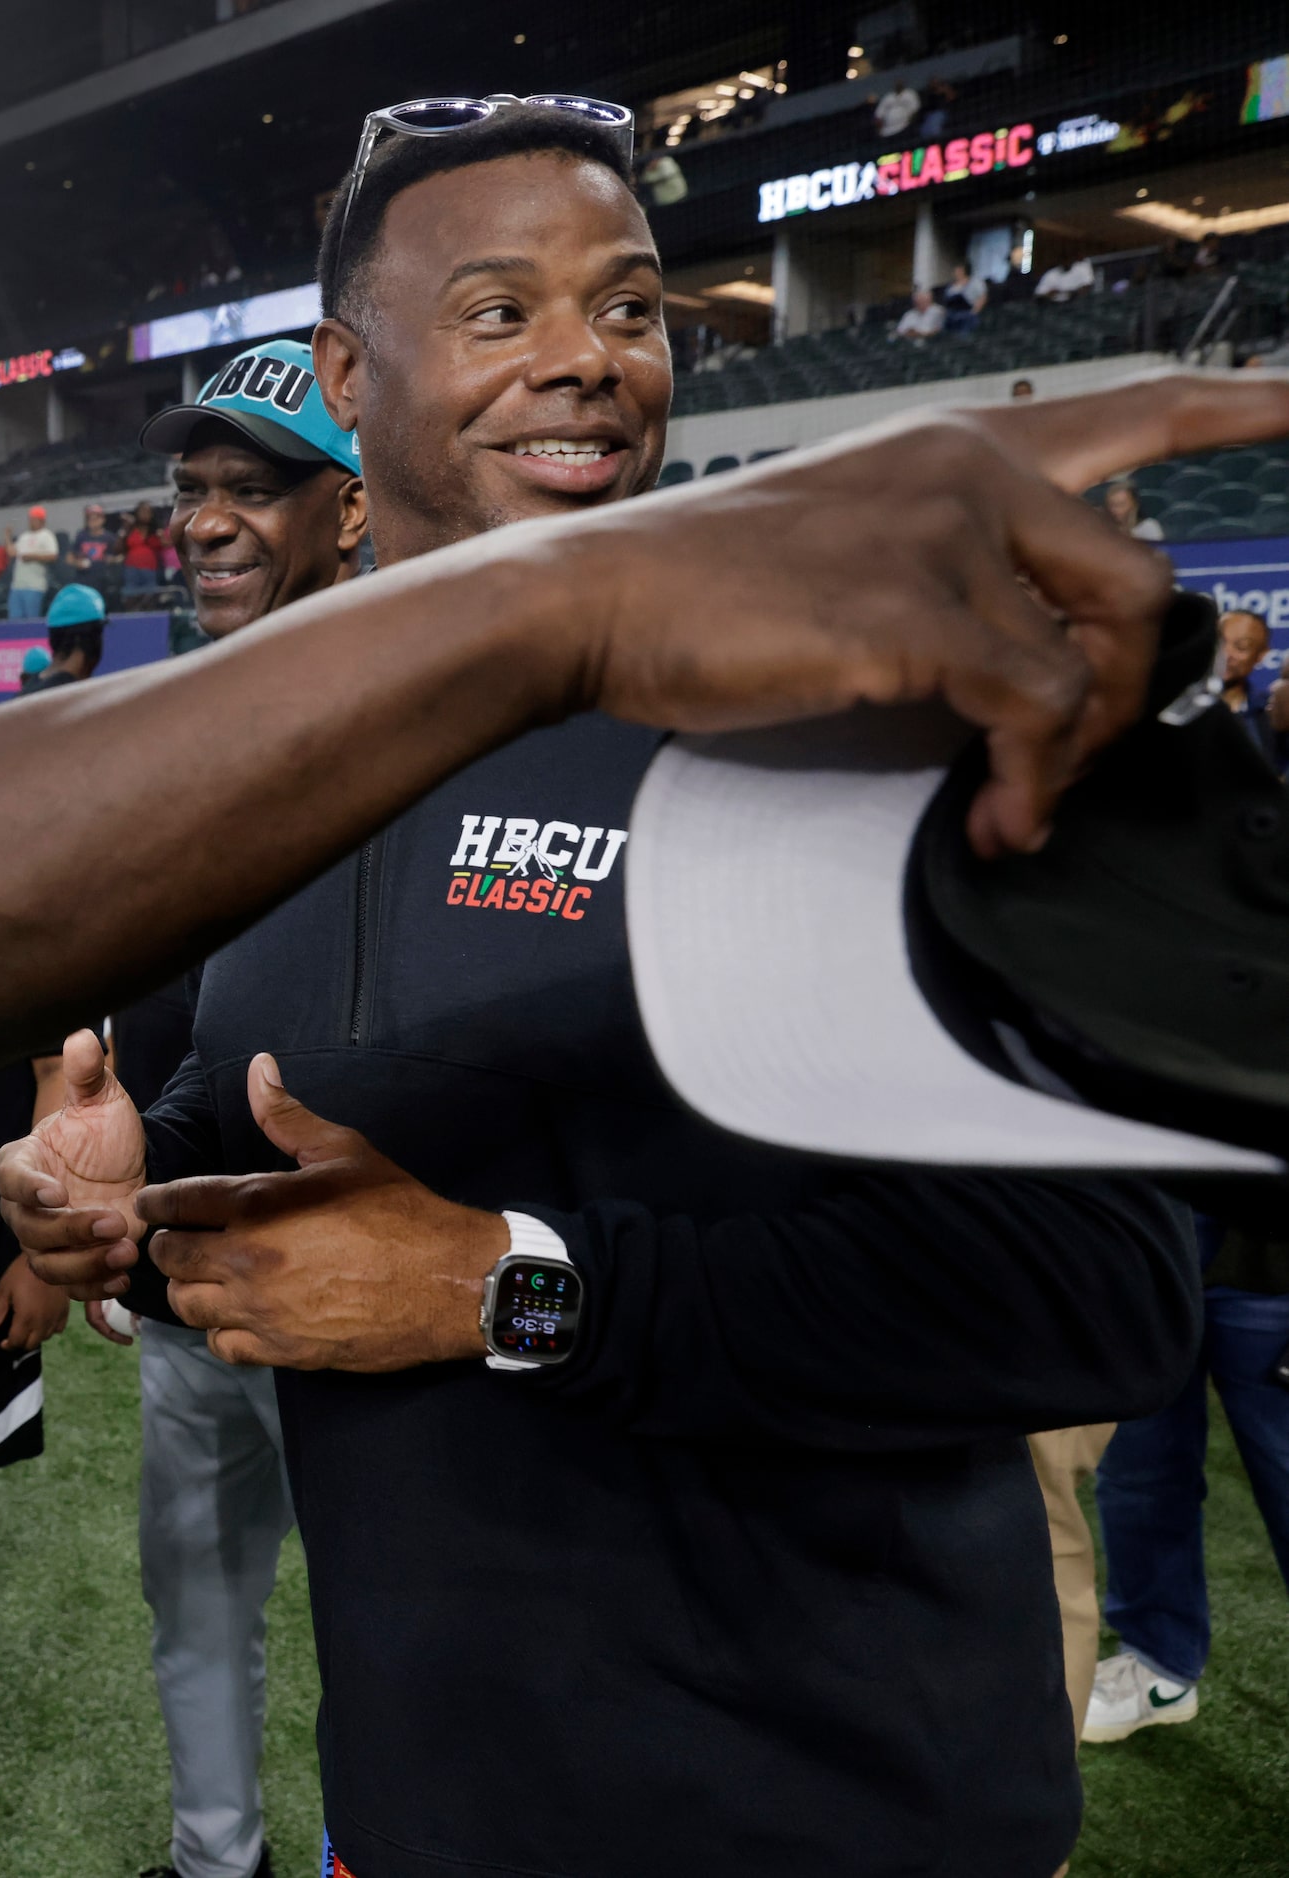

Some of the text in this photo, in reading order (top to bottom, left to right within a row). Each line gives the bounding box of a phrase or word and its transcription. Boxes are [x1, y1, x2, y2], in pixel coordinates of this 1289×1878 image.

[757, 162, 860, 223] HBCU
[449, 814, 629, 882] HBCU
[446, 872, 592, 921] CLASSIC
[512, 1316, 556, 1335] 5:36
